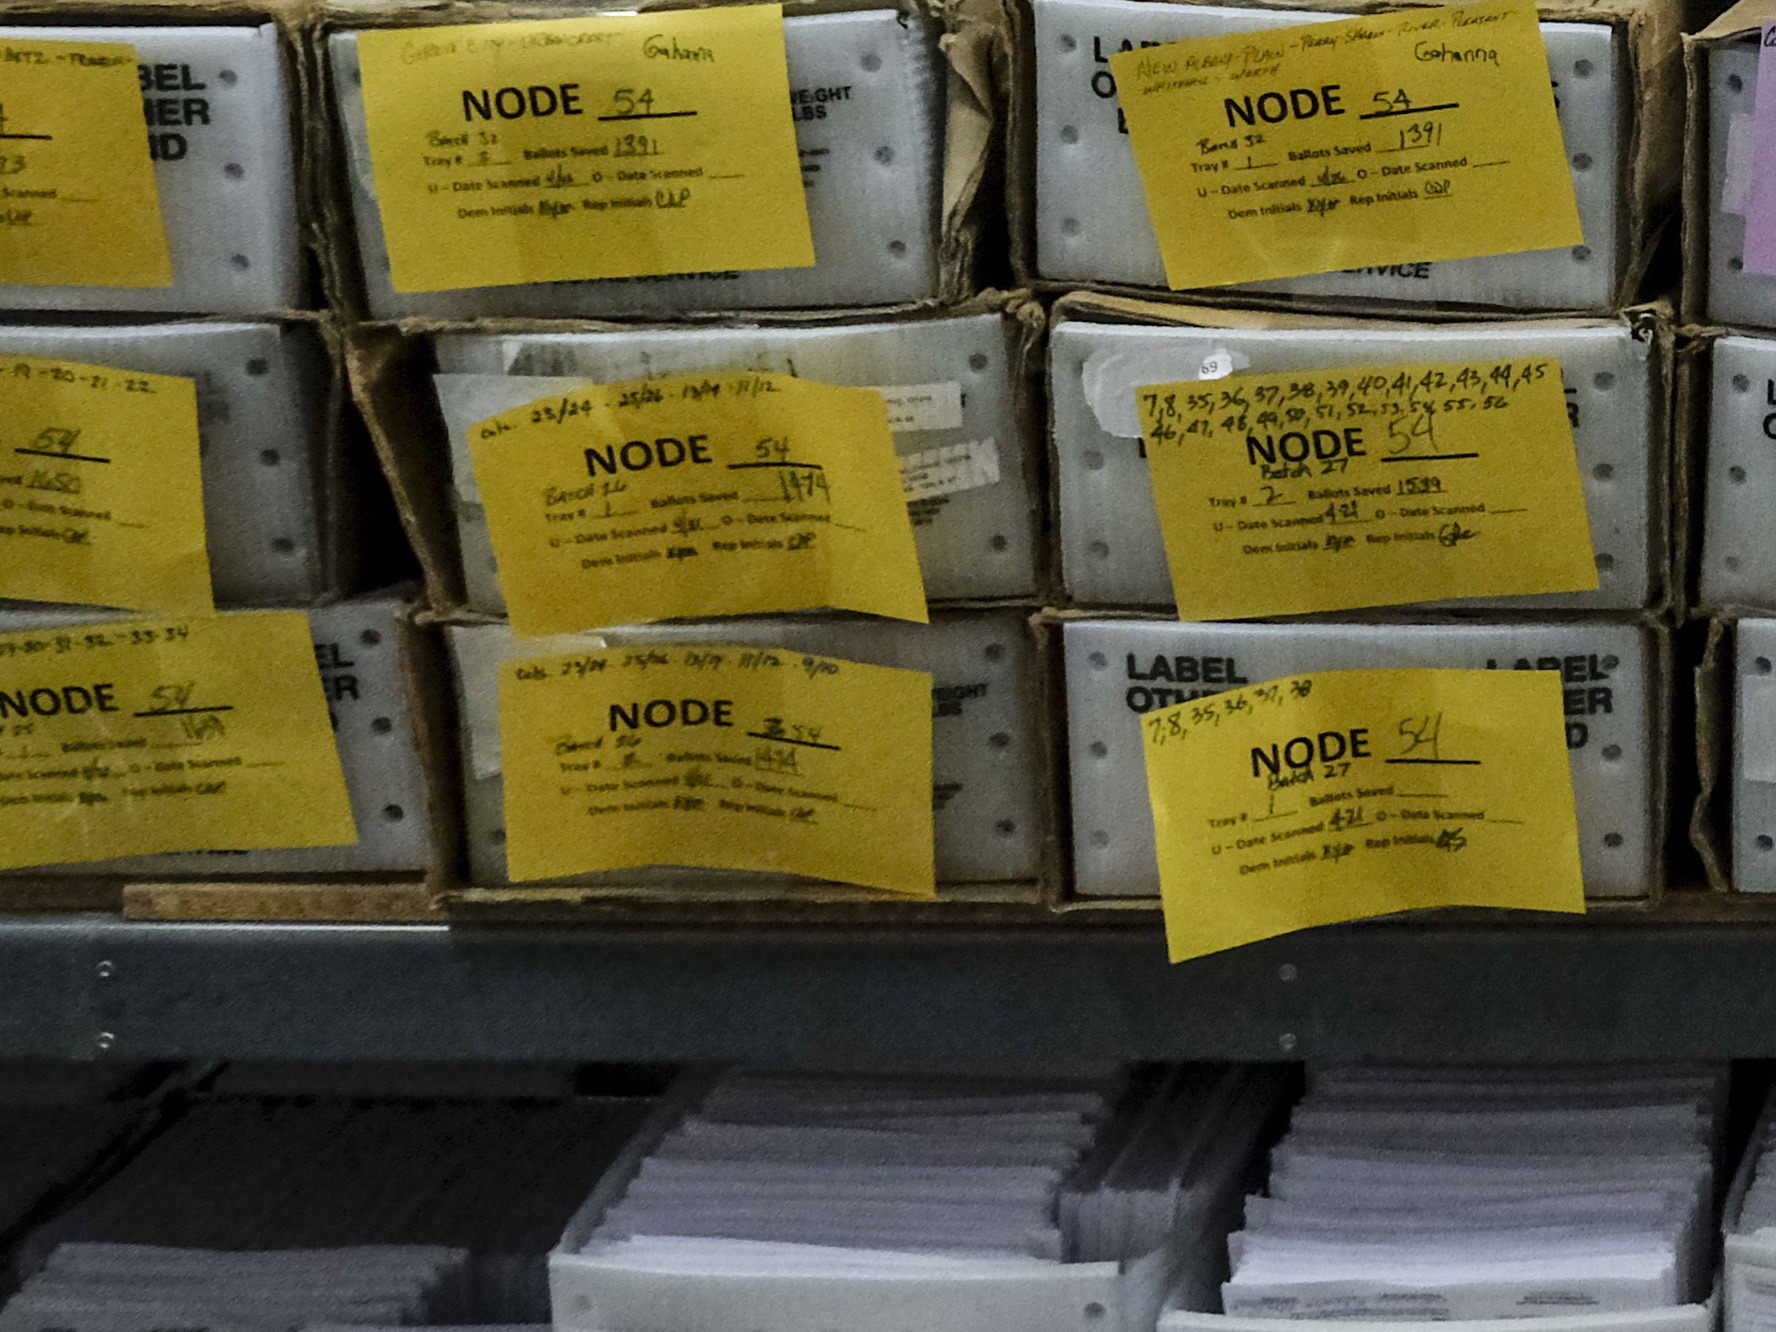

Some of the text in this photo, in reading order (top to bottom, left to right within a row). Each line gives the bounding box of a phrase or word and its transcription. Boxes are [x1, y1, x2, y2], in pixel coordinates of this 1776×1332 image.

[463, 84, 656, 121] NODE 54
[1225, 85, 1412, 127] NODE 54
[1246, 427, 1367, 466] NODE
[1127, 653, 1246, 685] LABEL
[1250, 712, 1443, 777] NODE 54
